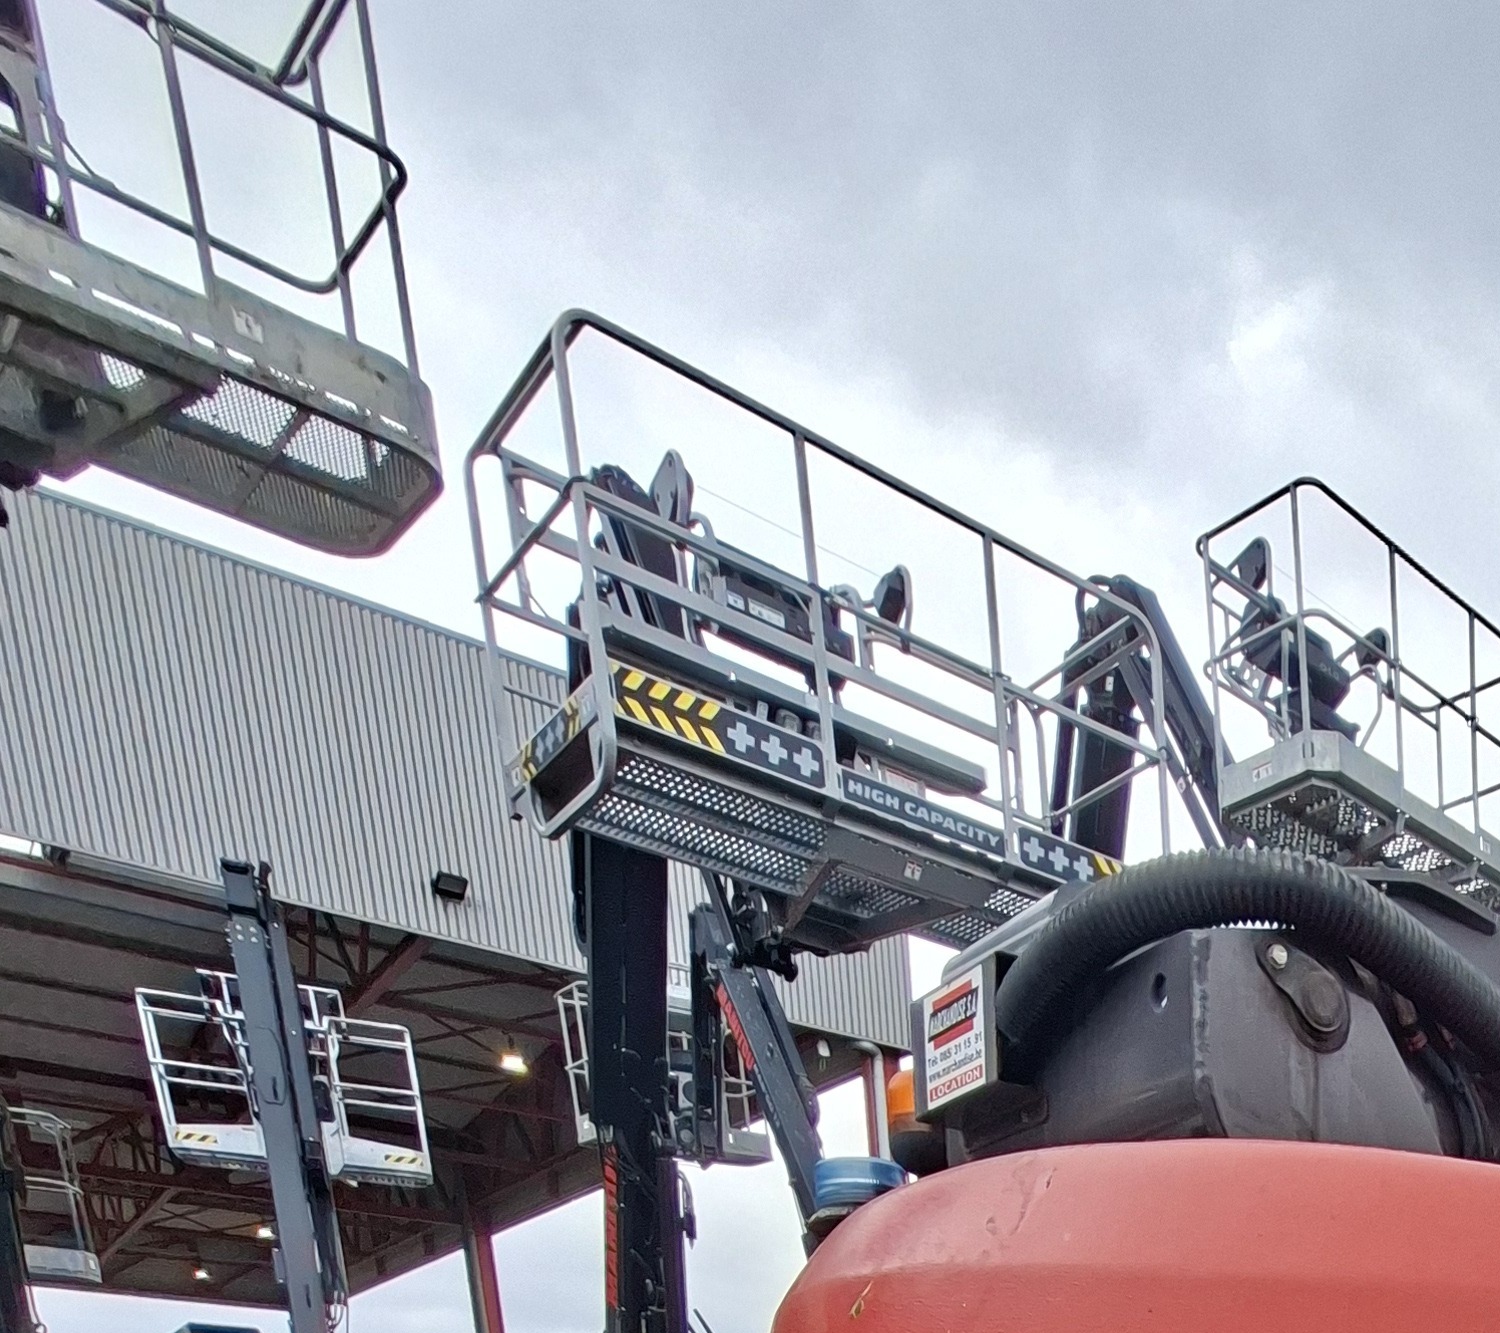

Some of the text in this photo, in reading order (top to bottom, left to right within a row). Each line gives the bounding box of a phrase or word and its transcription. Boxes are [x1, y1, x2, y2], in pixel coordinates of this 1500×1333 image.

[848, 779, 900, 811] HIGH
[904, 801, 1000, 847] CAPACITY
[953, 1042, 962, 1055] 31
[963, 1037, 972, 1049] 15
[931, 1064, 982, 1101] LOCATION
